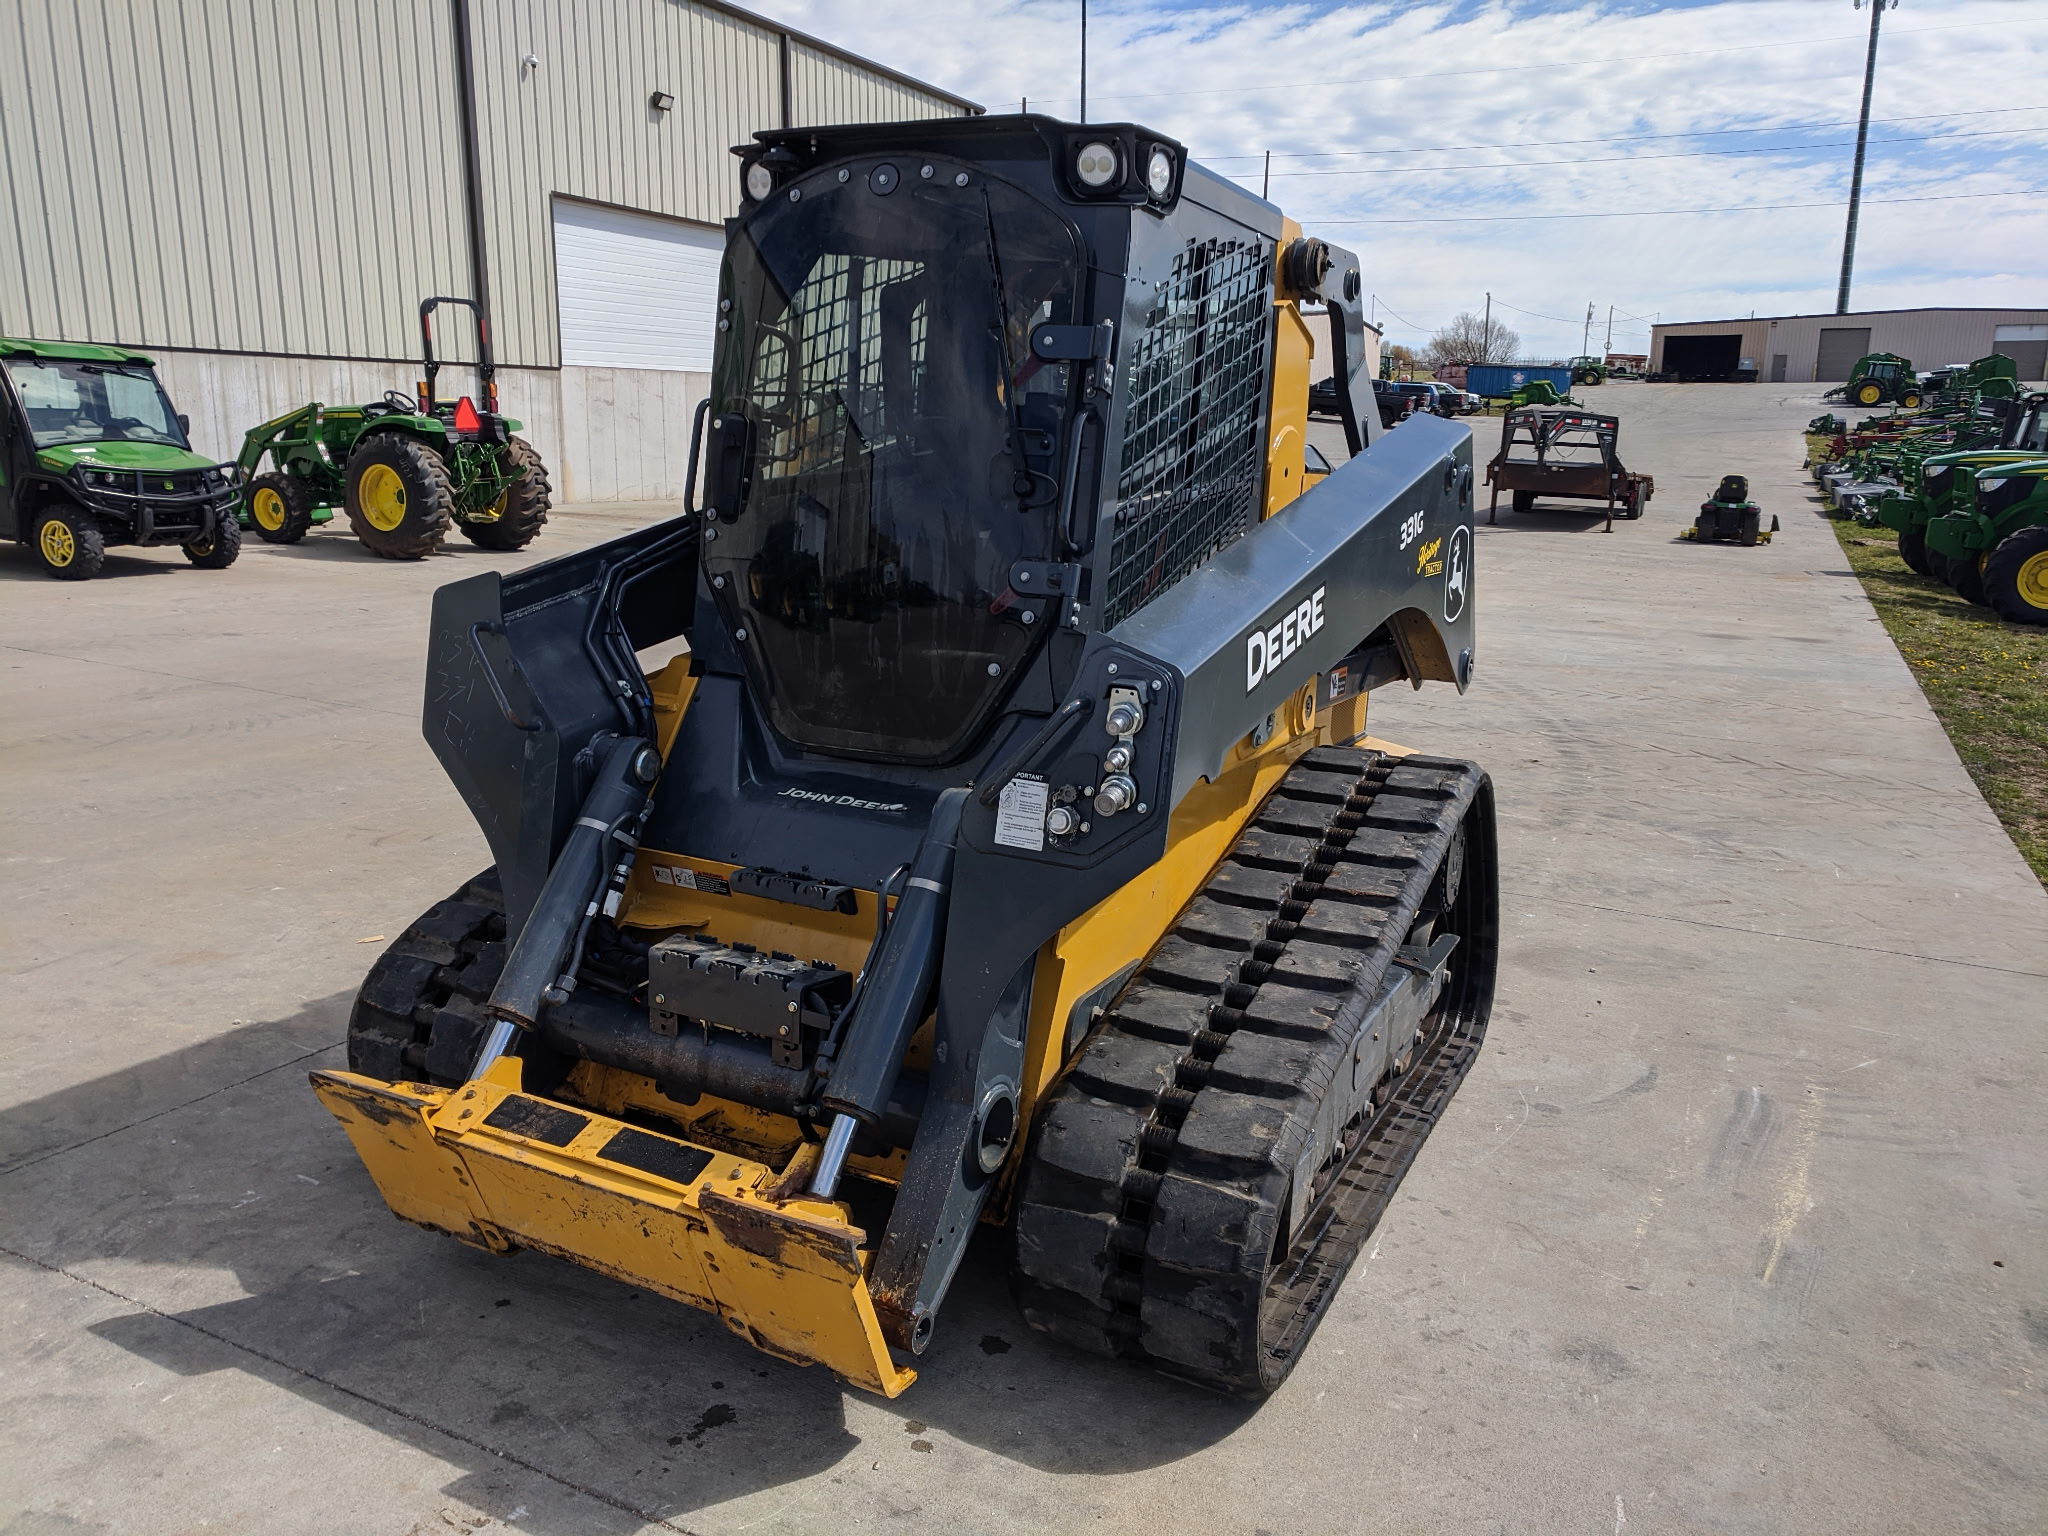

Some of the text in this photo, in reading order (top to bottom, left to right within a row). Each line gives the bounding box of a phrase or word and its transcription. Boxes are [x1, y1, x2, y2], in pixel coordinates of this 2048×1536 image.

[1399, 510, 1424, 551] 331G
[1247, 586, 1325, 692] DEERE
[777, 787, 836, 803] JOHN
